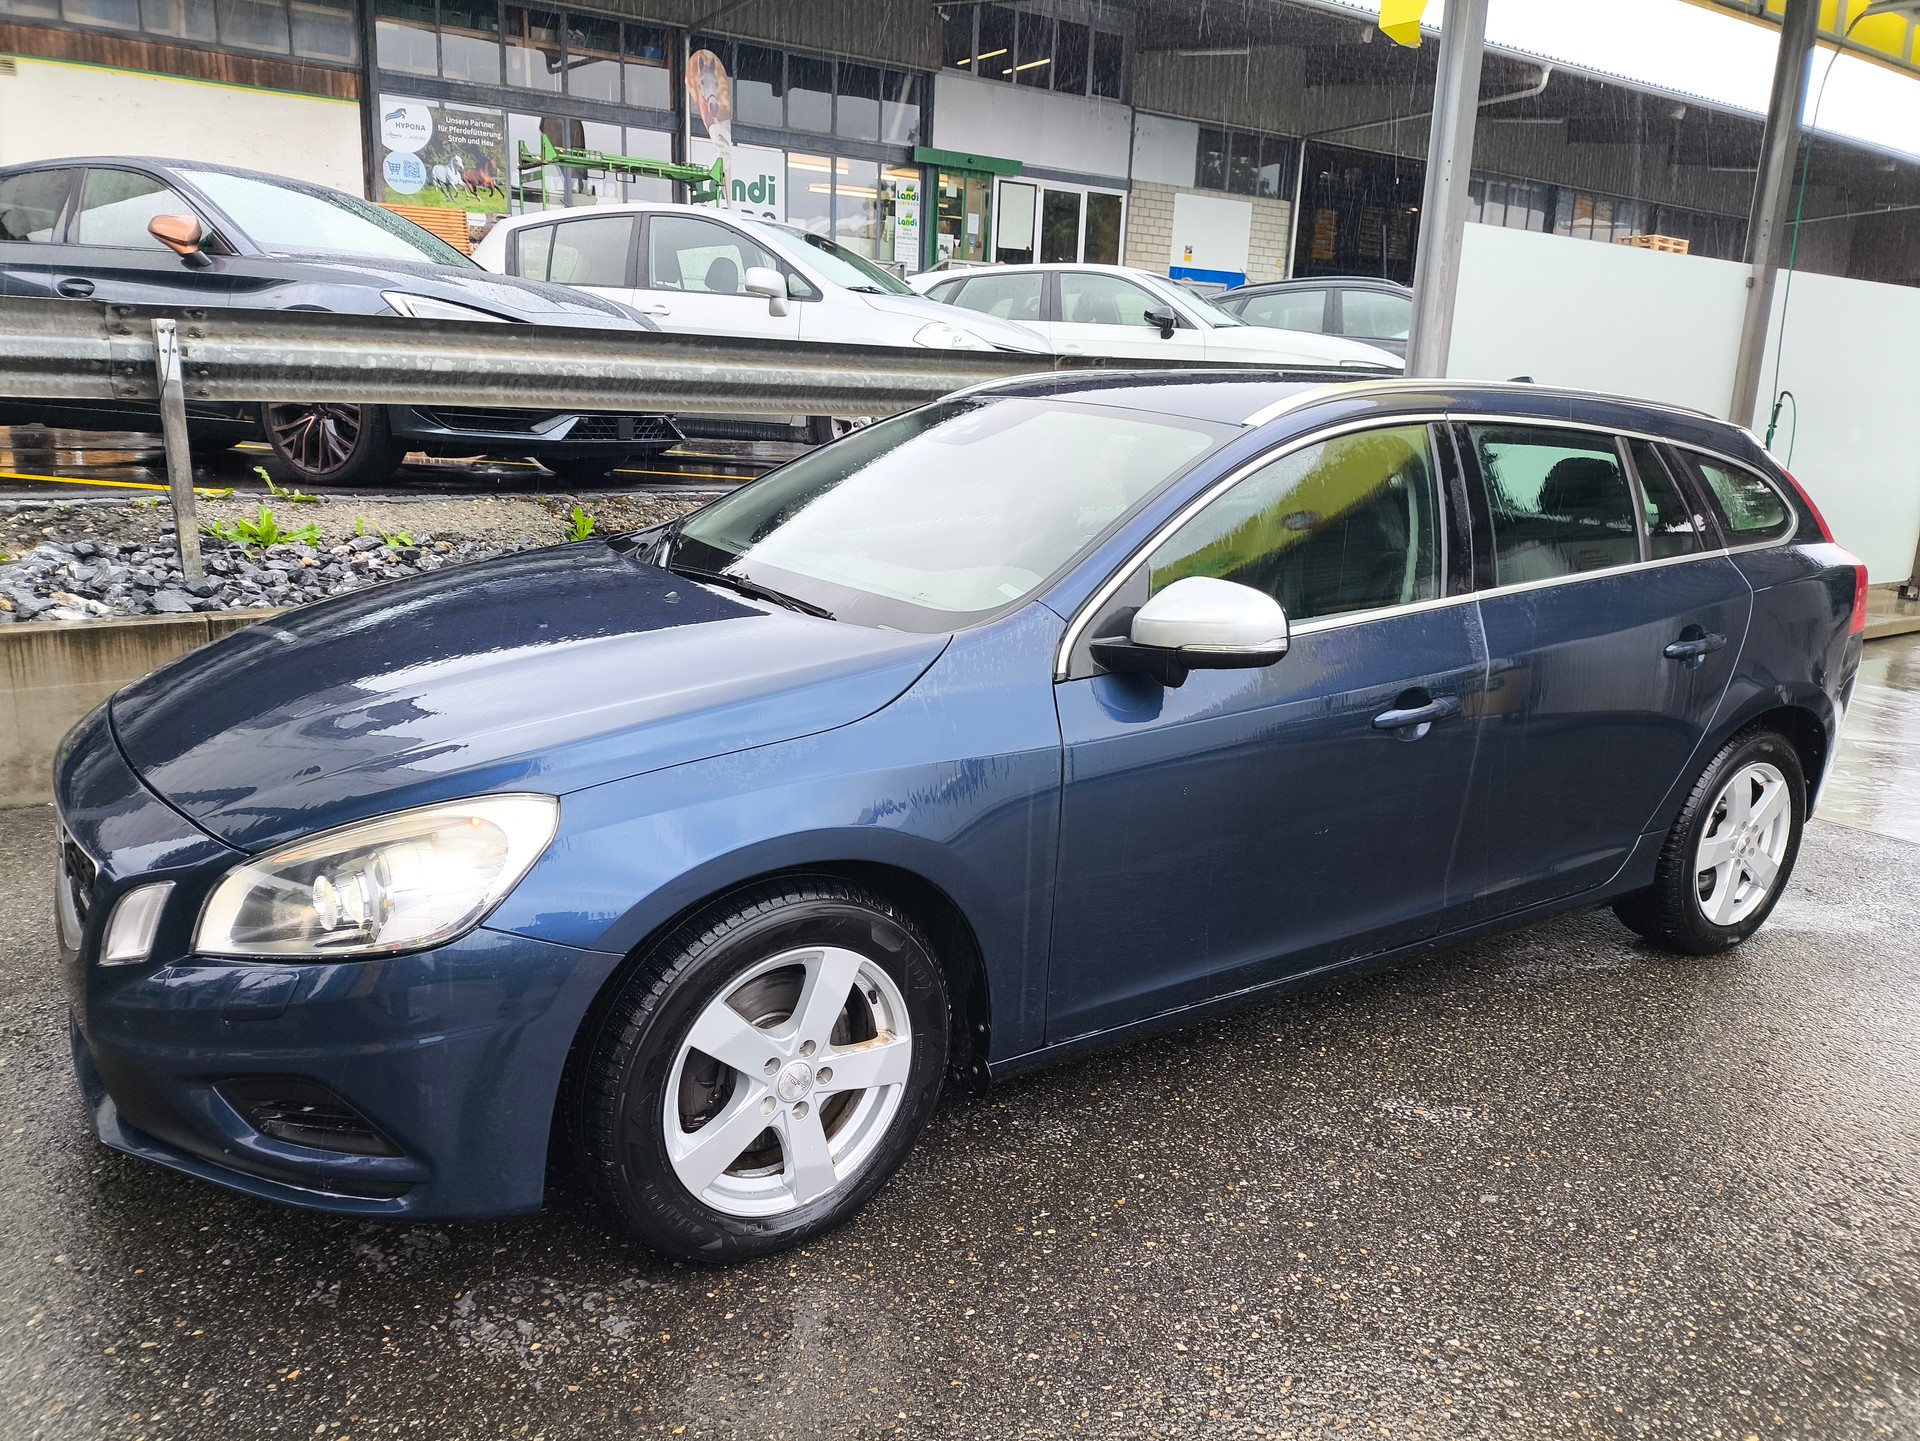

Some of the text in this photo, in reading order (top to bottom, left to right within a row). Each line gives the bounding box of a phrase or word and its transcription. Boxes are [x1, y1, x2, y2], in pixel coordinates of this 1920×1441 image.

[395, 121, 426, 132] HYPONA
[445, 116, 495, 129] Unsere Partner
[437, 124, 504, 140] für Pferdefütterung,
[447, 134, 494, 147] Stroh und Heu
[897, 189, 919, 201] Landi
[897, 216, 918, 227] Landi
